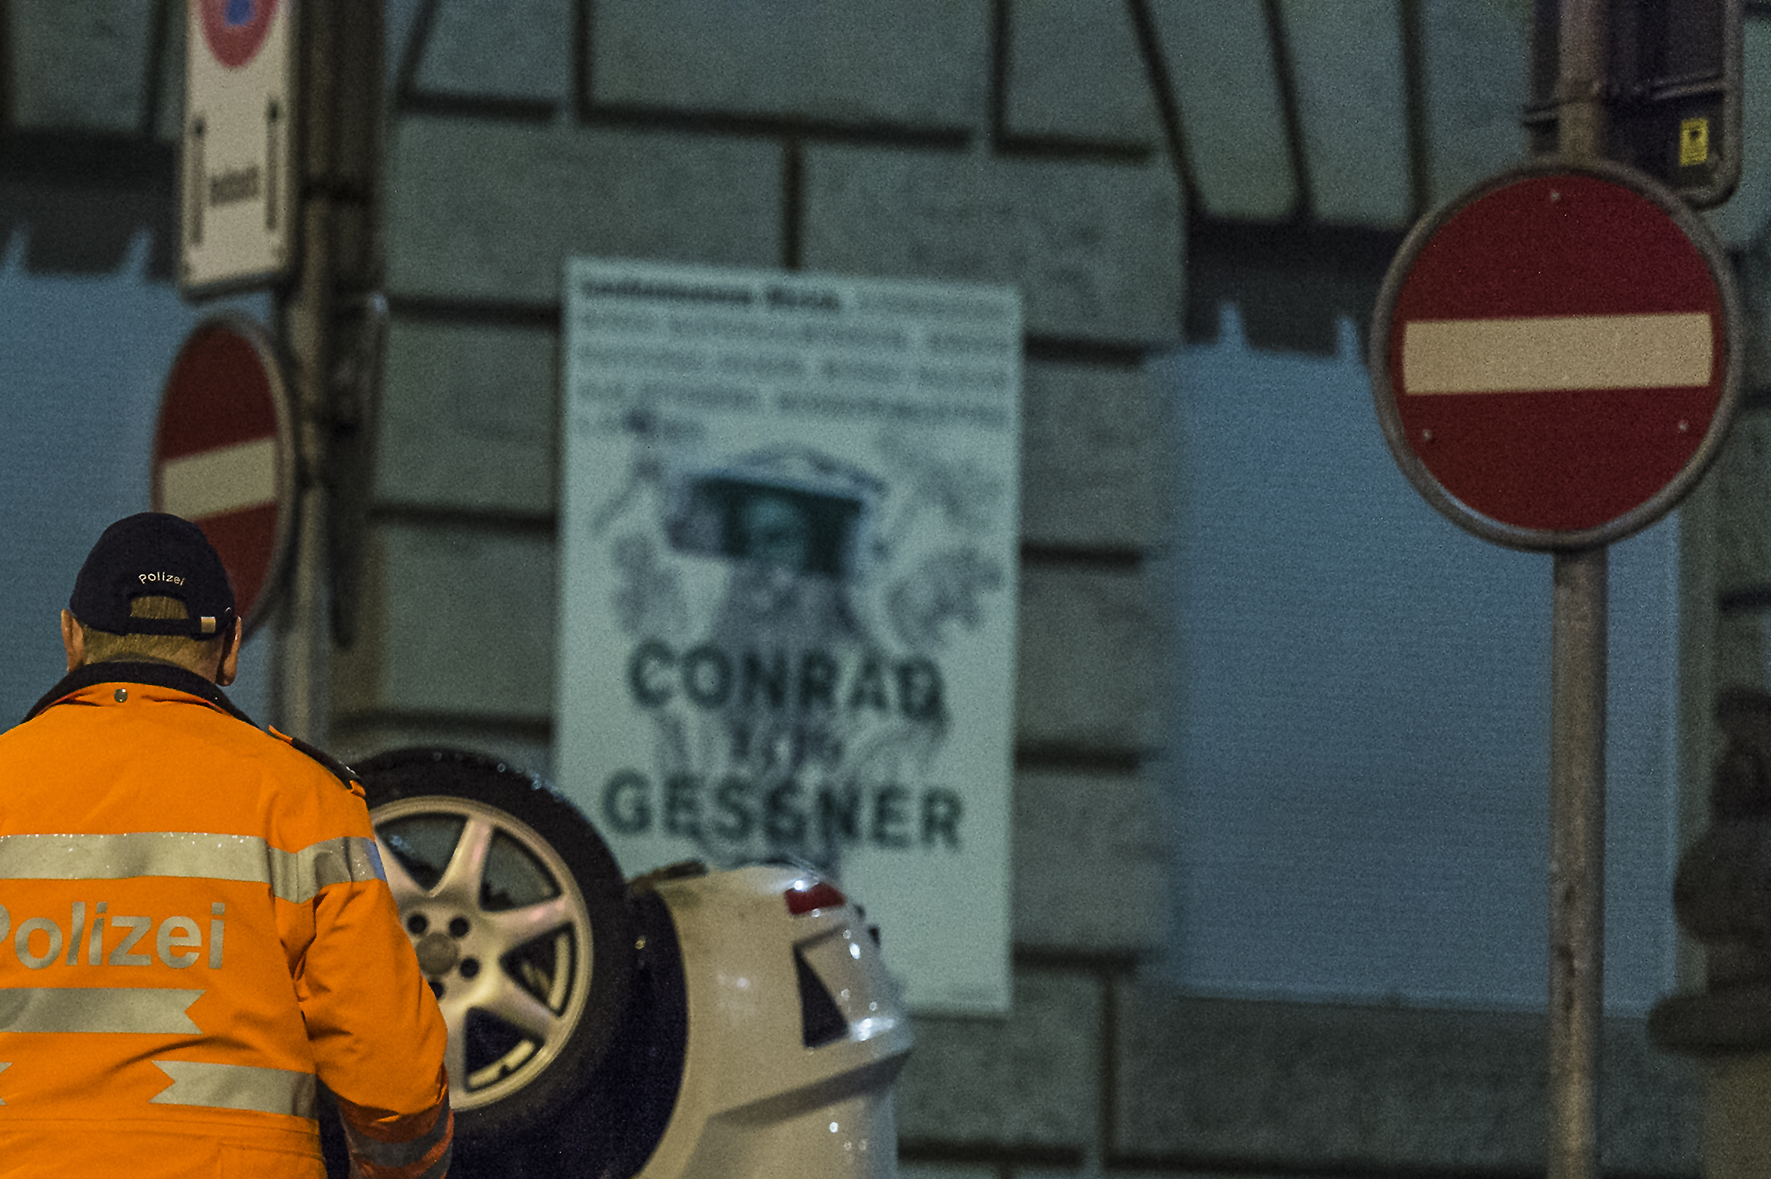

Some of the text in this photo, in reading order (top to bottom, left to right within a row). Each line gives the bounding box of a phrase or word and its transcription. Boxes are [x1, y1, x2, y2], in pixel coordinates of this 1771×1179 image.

[138, 571, 186, 587] Polizei
[628, 637, 947, 722] CONRAD
[601, 768, 966, 853] GESSNER
